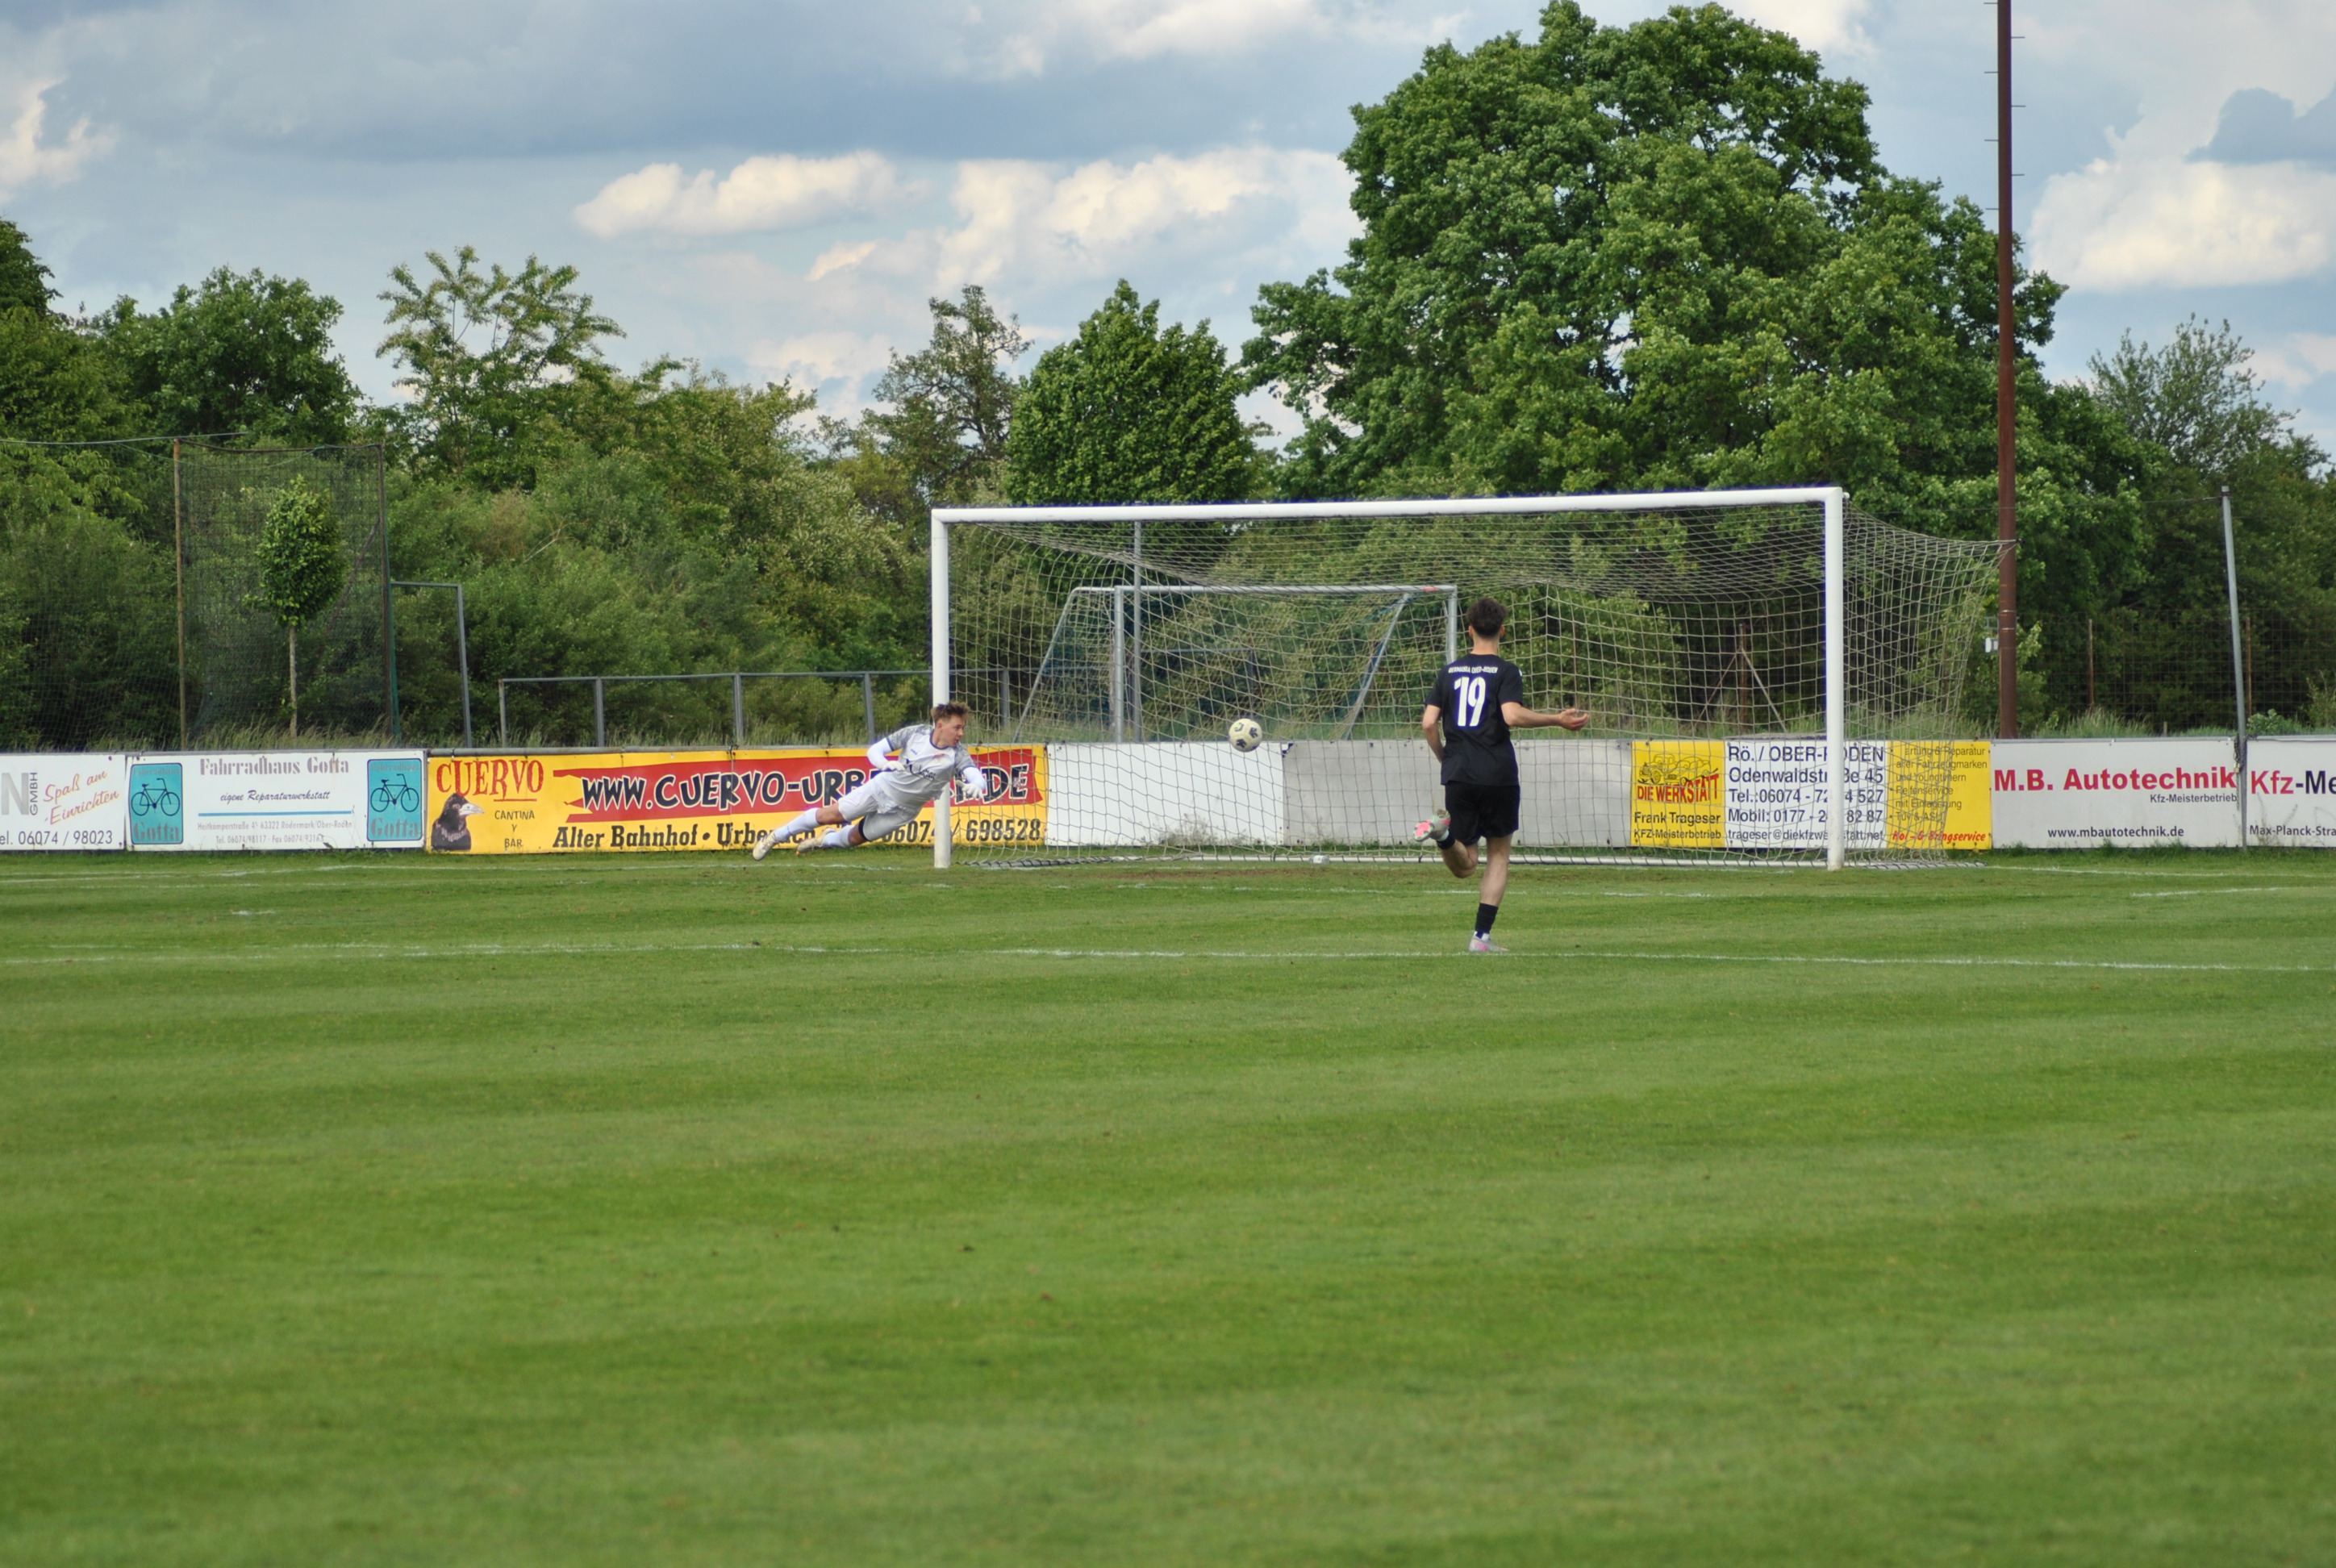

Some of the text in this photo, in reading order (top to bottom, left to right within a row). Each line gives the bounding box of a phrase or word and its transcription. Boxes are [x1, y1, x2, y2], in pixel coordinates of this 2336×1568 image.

[1454, 676, 1486, 727] 19
[1729, 745, 1754, 761] Rö.
[200, 757, 349, 775] Fahrradhaus Gotta
[436, 759, 544, 799] CUERVO
[1864, 767, 1883, 783] 45
[1994, 766, 2237, 791] M.B. Autotechnik
[30, 772, 39, 815] GMBH
[43, 771, 107, 804] Spaß am
[1637, 774, 1719, 803] DIE WERKSTATT
[220, 790, 330, 804] eigene Reparaturwerkstatt
[1858, 789, 1883, 803] 527
[2150, 793, 2238, 803] Kfz-Meisterbetrieb
[48, 790, 119, 825] Einrichten
[494, 810, 535, 819] CANTINA
[1634, 811, 1721, 826] Frank Trageser
[1728, 809, 1770, 822] Mobil:
[1774, 809, 1805, 822] 0177
[133, 821, 180, 841] Gotta
[261, 820, 279, 830] 63322
[371, 817, 419, 838] Gotta
[511, 824, 517, 832] Y
[2047, 825, 2184, 838] www.mbautotechnik.de
[19, 831, 59, 845] 06074
[73, 830, 113, 844] 98023
[216, 835, 226, 844] Tel.
[272, 835, 282, 843] Fax
[553, 826, 605, 847] Alter
[611, 824, 699, 847] Bahnhof
[966, 819, 1041, 841] 698528
[1634, 828, 1721, 839] KFZ-Meisterbetrieb
[504, 838, 523, 848] BAR
